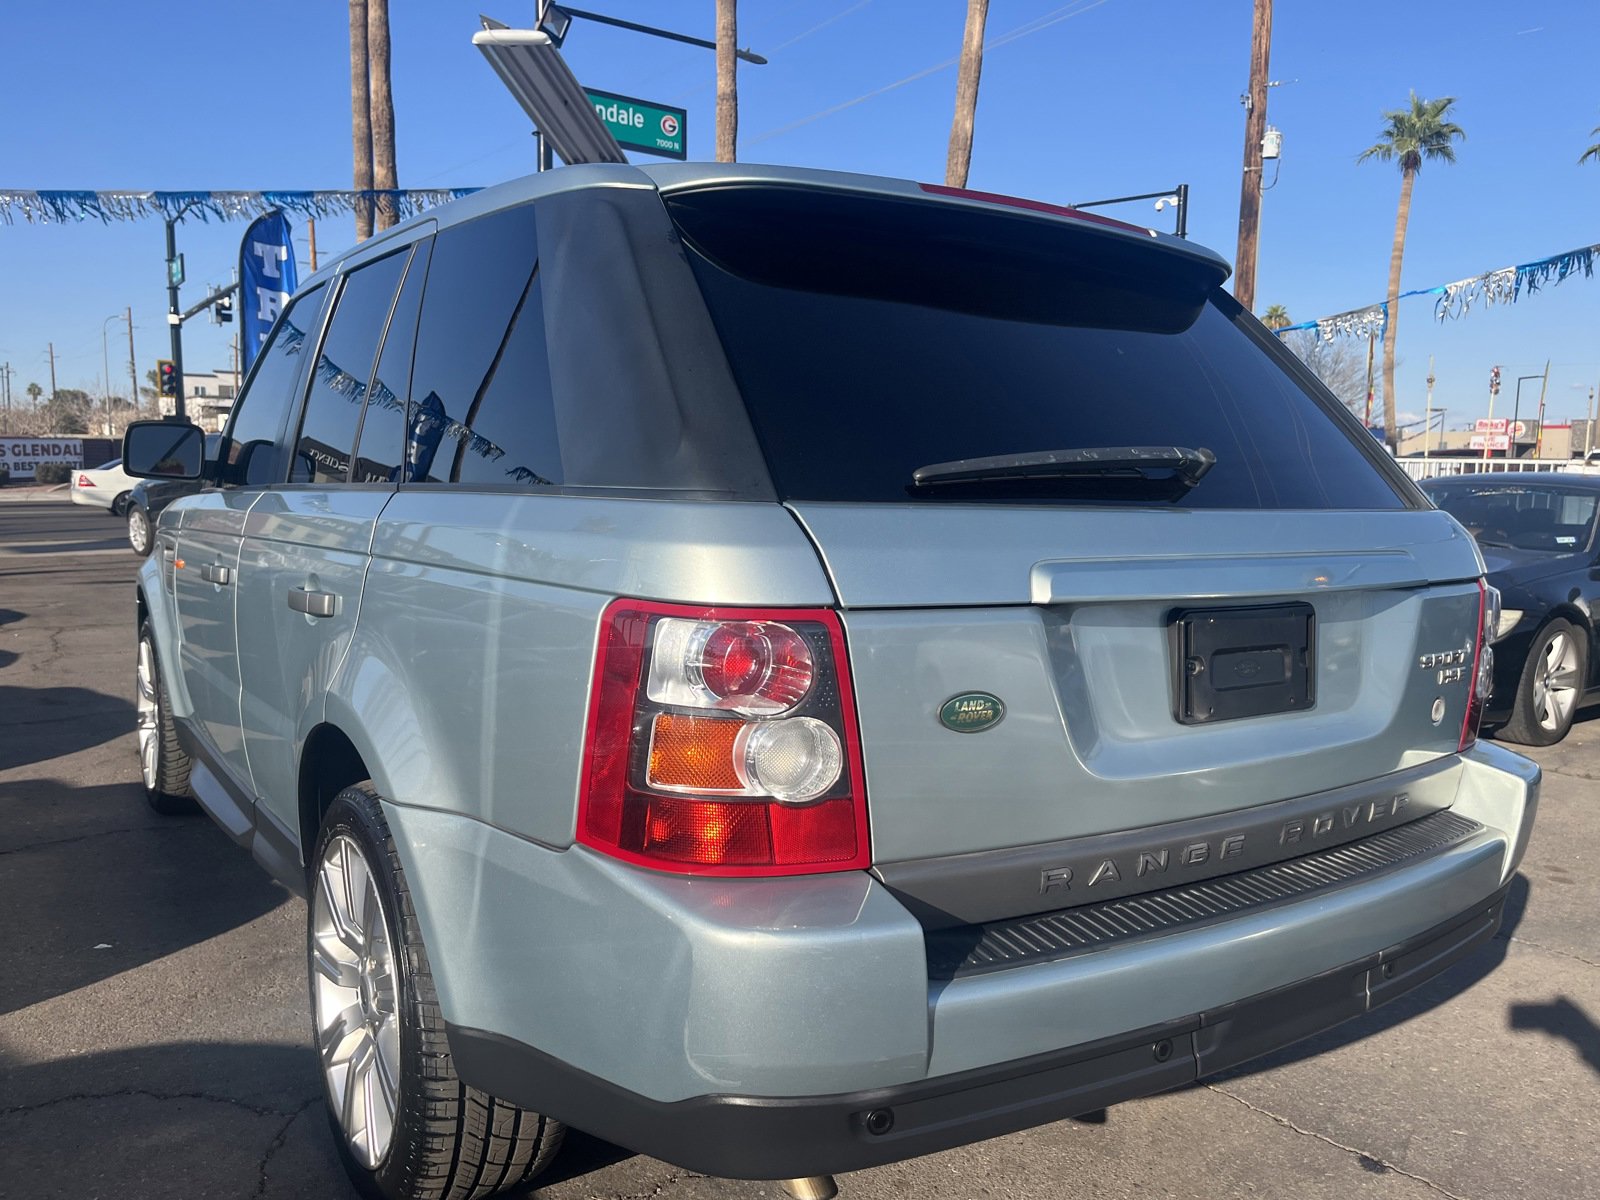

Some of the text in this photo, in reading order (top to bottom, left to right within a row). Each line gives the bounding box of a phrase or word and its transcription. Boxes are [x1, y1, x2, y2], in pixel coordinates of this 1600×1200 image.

[595, 103, 644, 128] ndale
[656, 138, 679, 150] 7000 N
[253, 241, 293, 343] TR
[11, 443, 83, 457] GLENDAL
[955, 699, 985, 712] LAND
[957, 709, 994, 722] ROVER
[1039, 791, 1411, 895] RANGE ROVER
